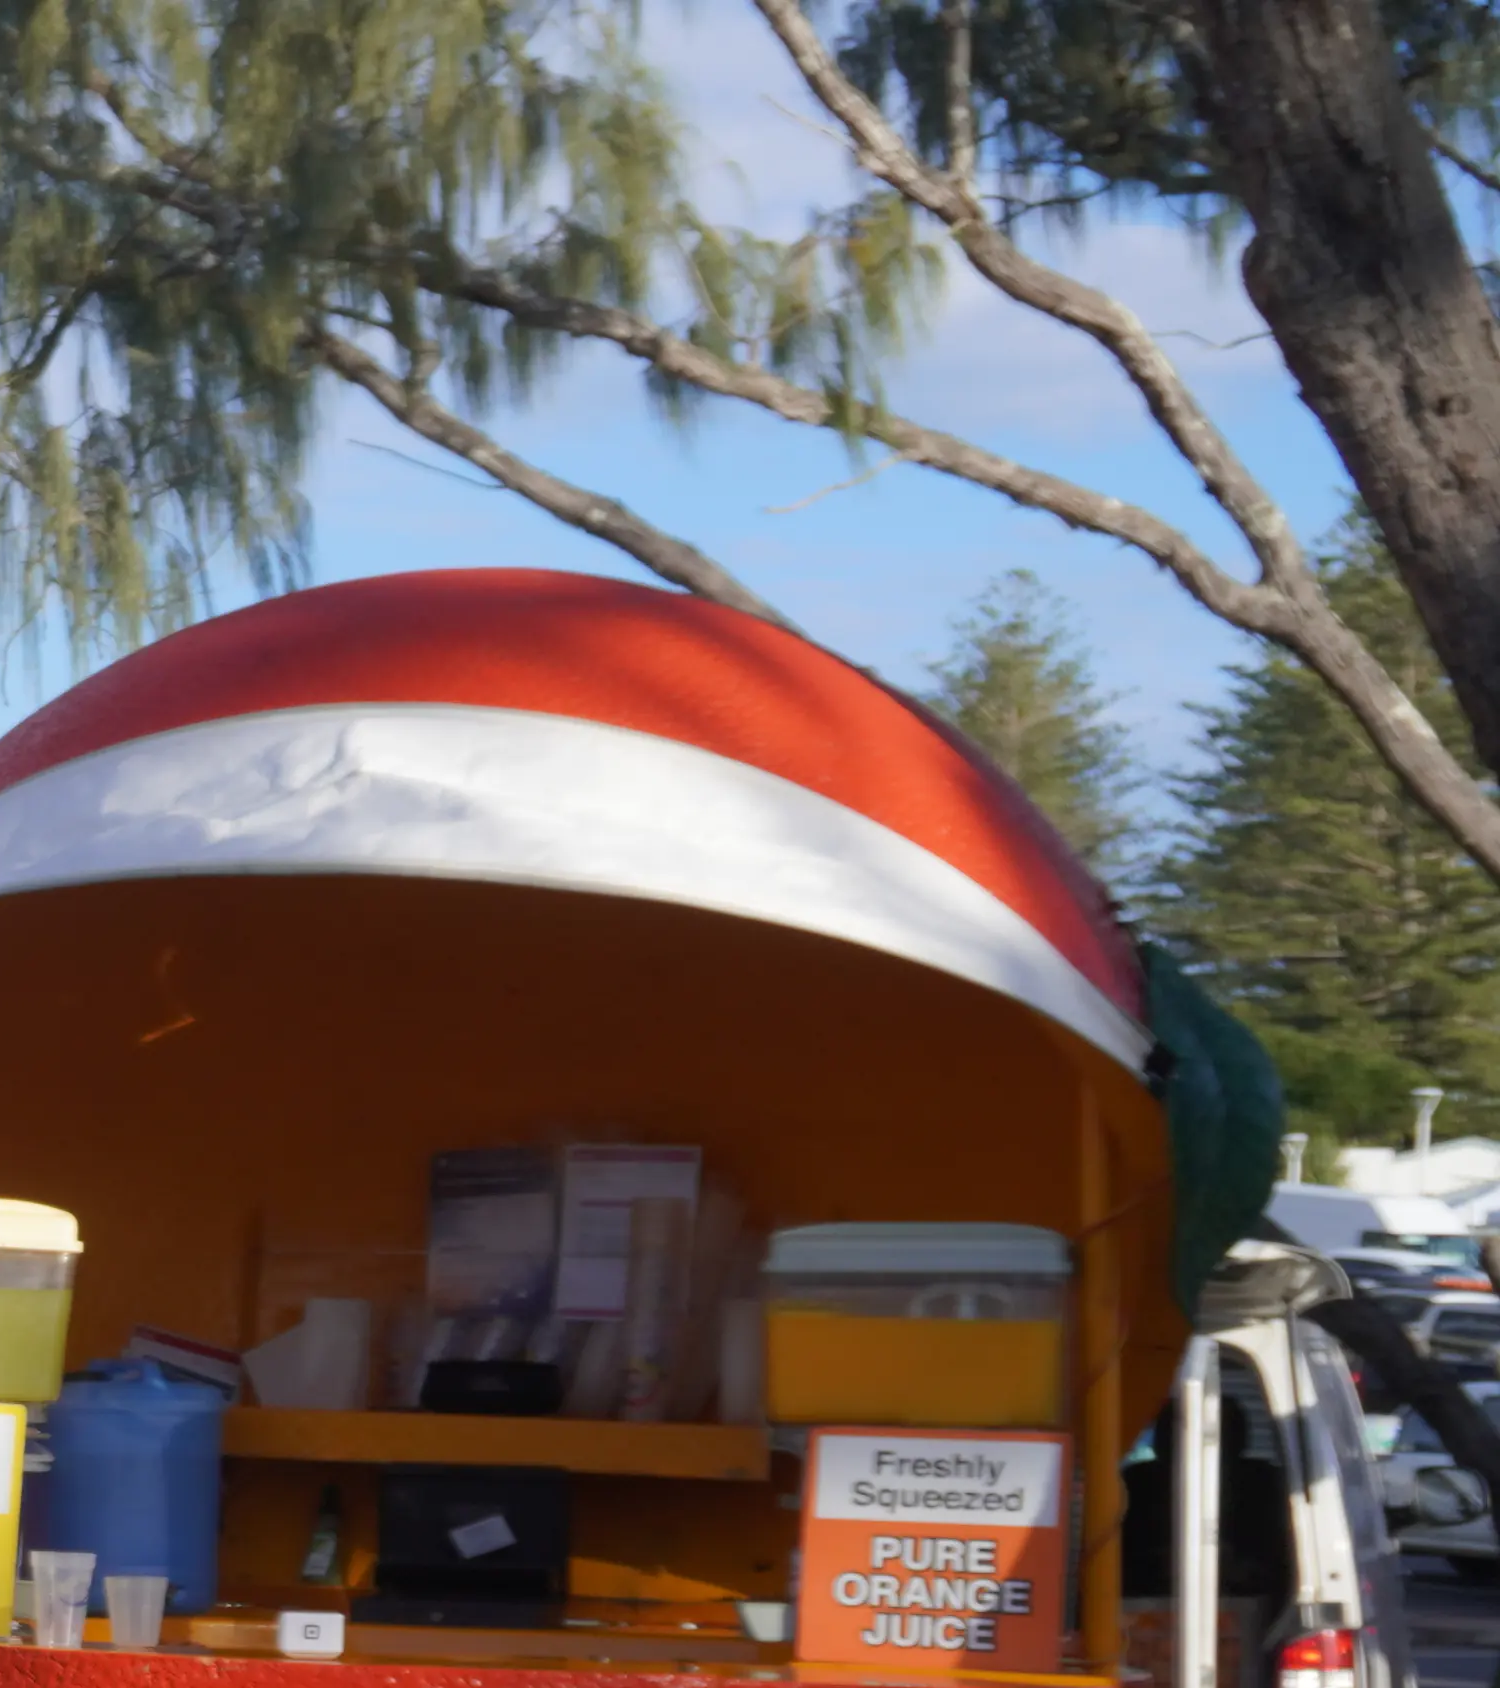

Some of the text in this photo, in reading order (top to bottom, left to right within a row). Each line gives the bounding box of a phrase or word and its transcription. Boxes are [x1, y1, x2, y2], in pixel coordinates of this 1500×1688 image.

[874, 1450, 1008, 1486] Freshly
[853, 1481, 1025, 1513] Squeezed
[870, 1535, 998, 1574] PURE
[832, 1572, 1033, 1614] ORANGE
[860, 1612, 998, 1652] JUICE
